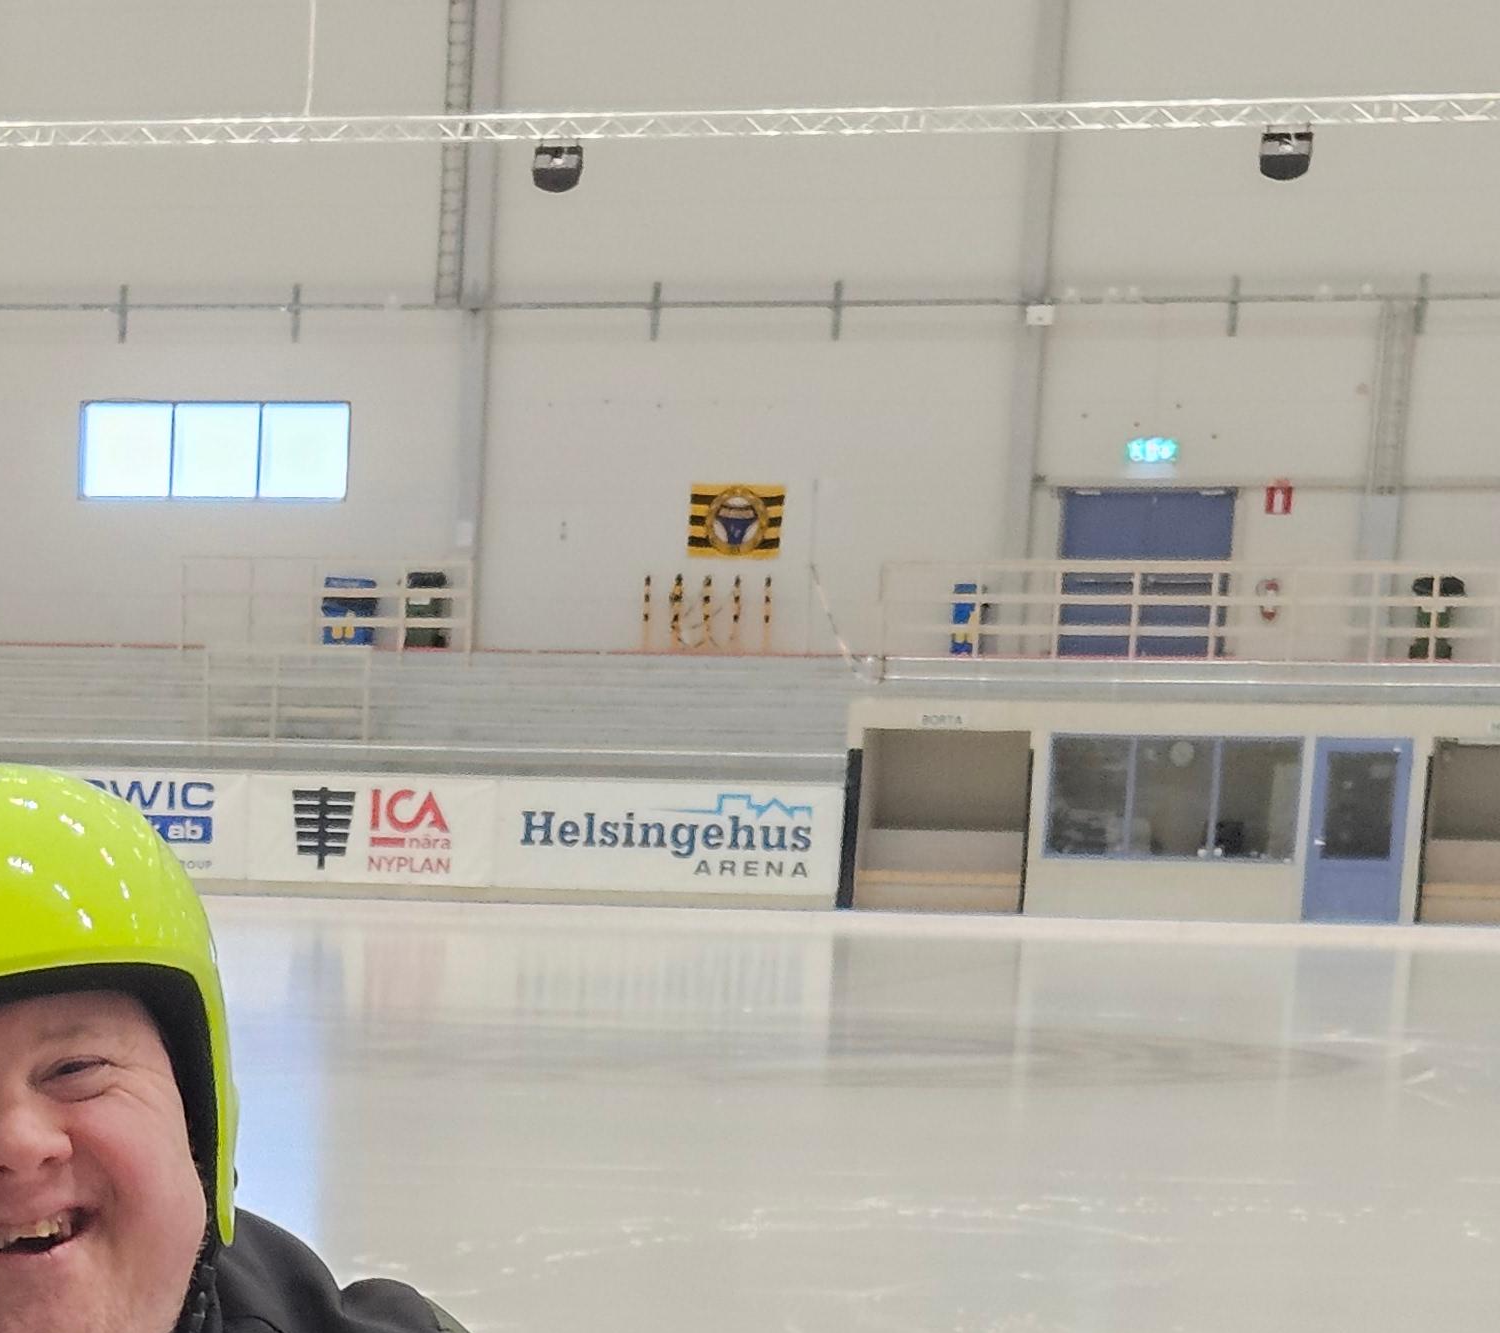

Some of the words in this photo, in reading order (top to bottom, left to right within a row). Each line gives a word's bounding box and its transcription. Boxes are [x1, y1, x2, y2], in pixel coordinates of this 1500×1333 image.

[370, 788, 449, 833] ICA
[409, 836, 452, 850] nära
[520, 811, 812, 858] Helsingehus
[367, 856, 452, 874] NYPLAN
[694, 860, 809, 878] ARENA
